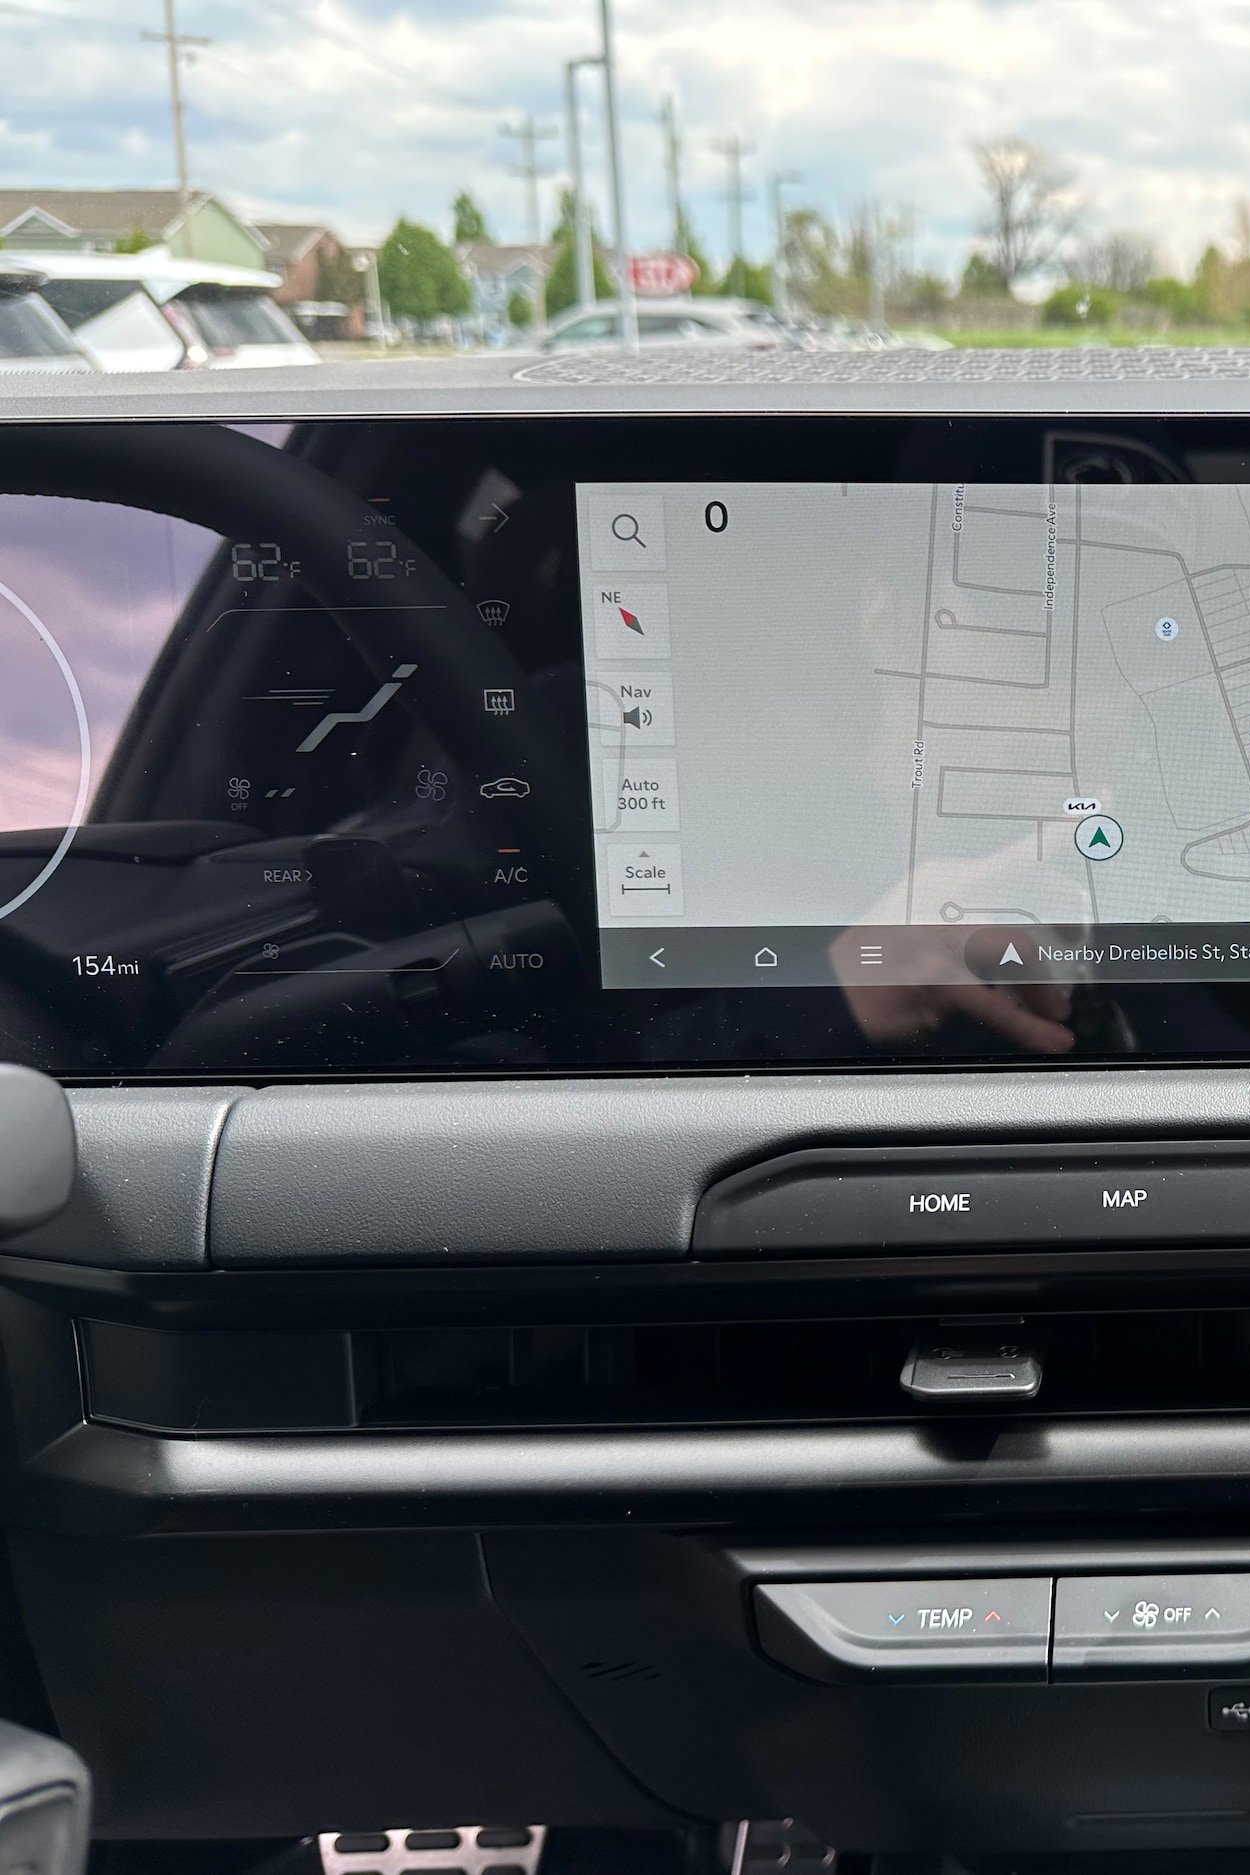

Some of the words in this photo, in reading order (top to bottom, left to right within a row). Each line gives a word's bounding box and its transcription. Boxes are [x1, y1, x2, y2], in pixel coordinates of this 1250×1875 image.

[363, 515, 396, 526] SYNC
[704, 500, 729, 533] 0
[1046, 503, 1057, 525] Ave
[1044, 527, 1057, 609] Independence
[601, 591, 622, 604] NE
[620, 685, 652, 698] Nav
[913, 741, 924, 756] Rd
[911, 758, 923, 788] Trout
[621, 778, 660, 791] Auto
[231, 802, 248, 811] OFF
[618, 797, 648, 810] 300
[651, 797, 666, 810] ft
[264, 869, 302, 882] REAR
[494, 867, 528, 885] A/C
[625, 866, 667, 879] Scale
[490, 953, 544, 969] AUTO
[1038, 945, 1104, 963] Nearby
[1109, 944, 1197, 960] Dreibelbis
[1202, 944, 1225, 962] St,
[909, 1193, 971, 1212] HOME
[1102, 1189, 1148, 1208] MAP
[917, 1608, 973, 1628] TEMP
[1163, 1607, 1192, 1622] OFF
